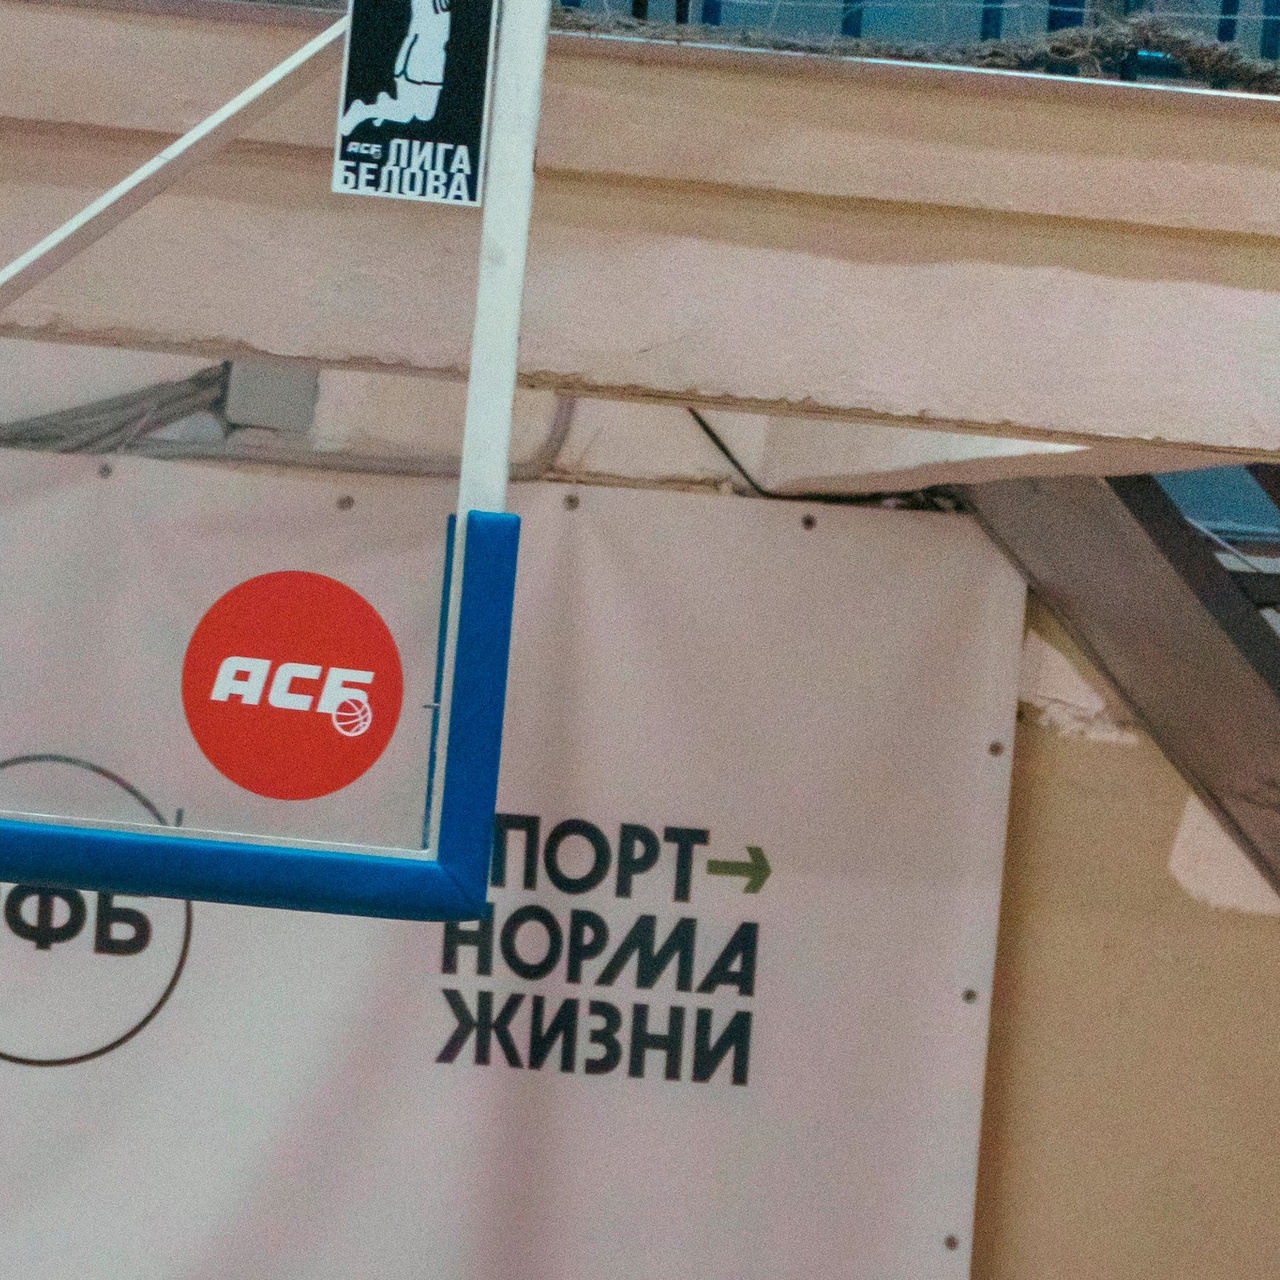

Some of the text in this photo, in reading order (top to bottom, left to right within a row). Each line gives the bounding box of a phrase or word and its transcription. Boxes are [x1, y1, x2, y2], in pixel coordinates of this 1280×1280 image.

[334, 160, 471, 201] БЕЛОВА
[386, 138, 471, 175] ЛИГА
[441, 902, 759, 997] НОРМА
[435, 988, 753, 1086] ЖИЗНИ
